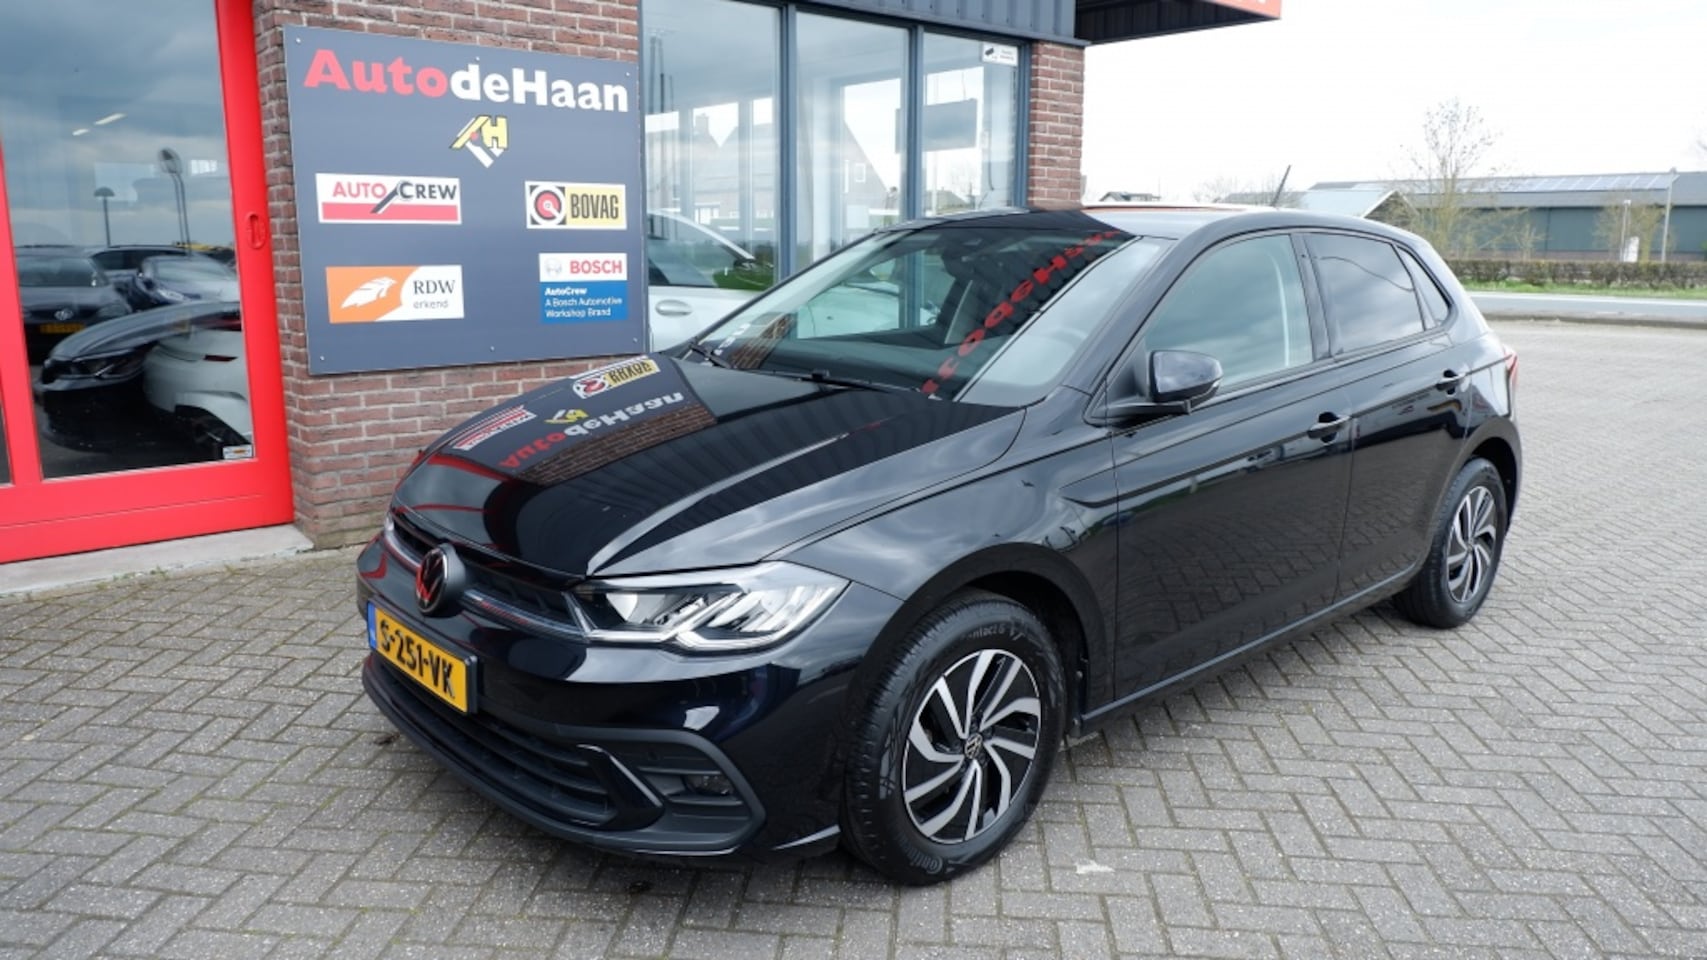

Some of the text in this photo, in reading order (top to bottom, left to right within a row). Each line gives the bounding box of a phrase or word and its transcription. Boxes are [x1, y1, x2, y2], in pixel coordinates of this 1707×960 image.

[303, 49, 629, 112] AutodeHaan
[332, 181, 457, 200] AUTO CREW
[570, 193, 619, 220] BOVAG
[570, 260, 623, 274] BOSCH
[413, 280, 456, 294] RDW
[544, 286, 588, 296] AutoCrew
[413, 300, 449, 309] erkend
[545, 296, 623, 307] A Bosch Automotive
[545, 307, 611, 318] Workshop Brand
[379, 618, 456, 699] S-251-VK
